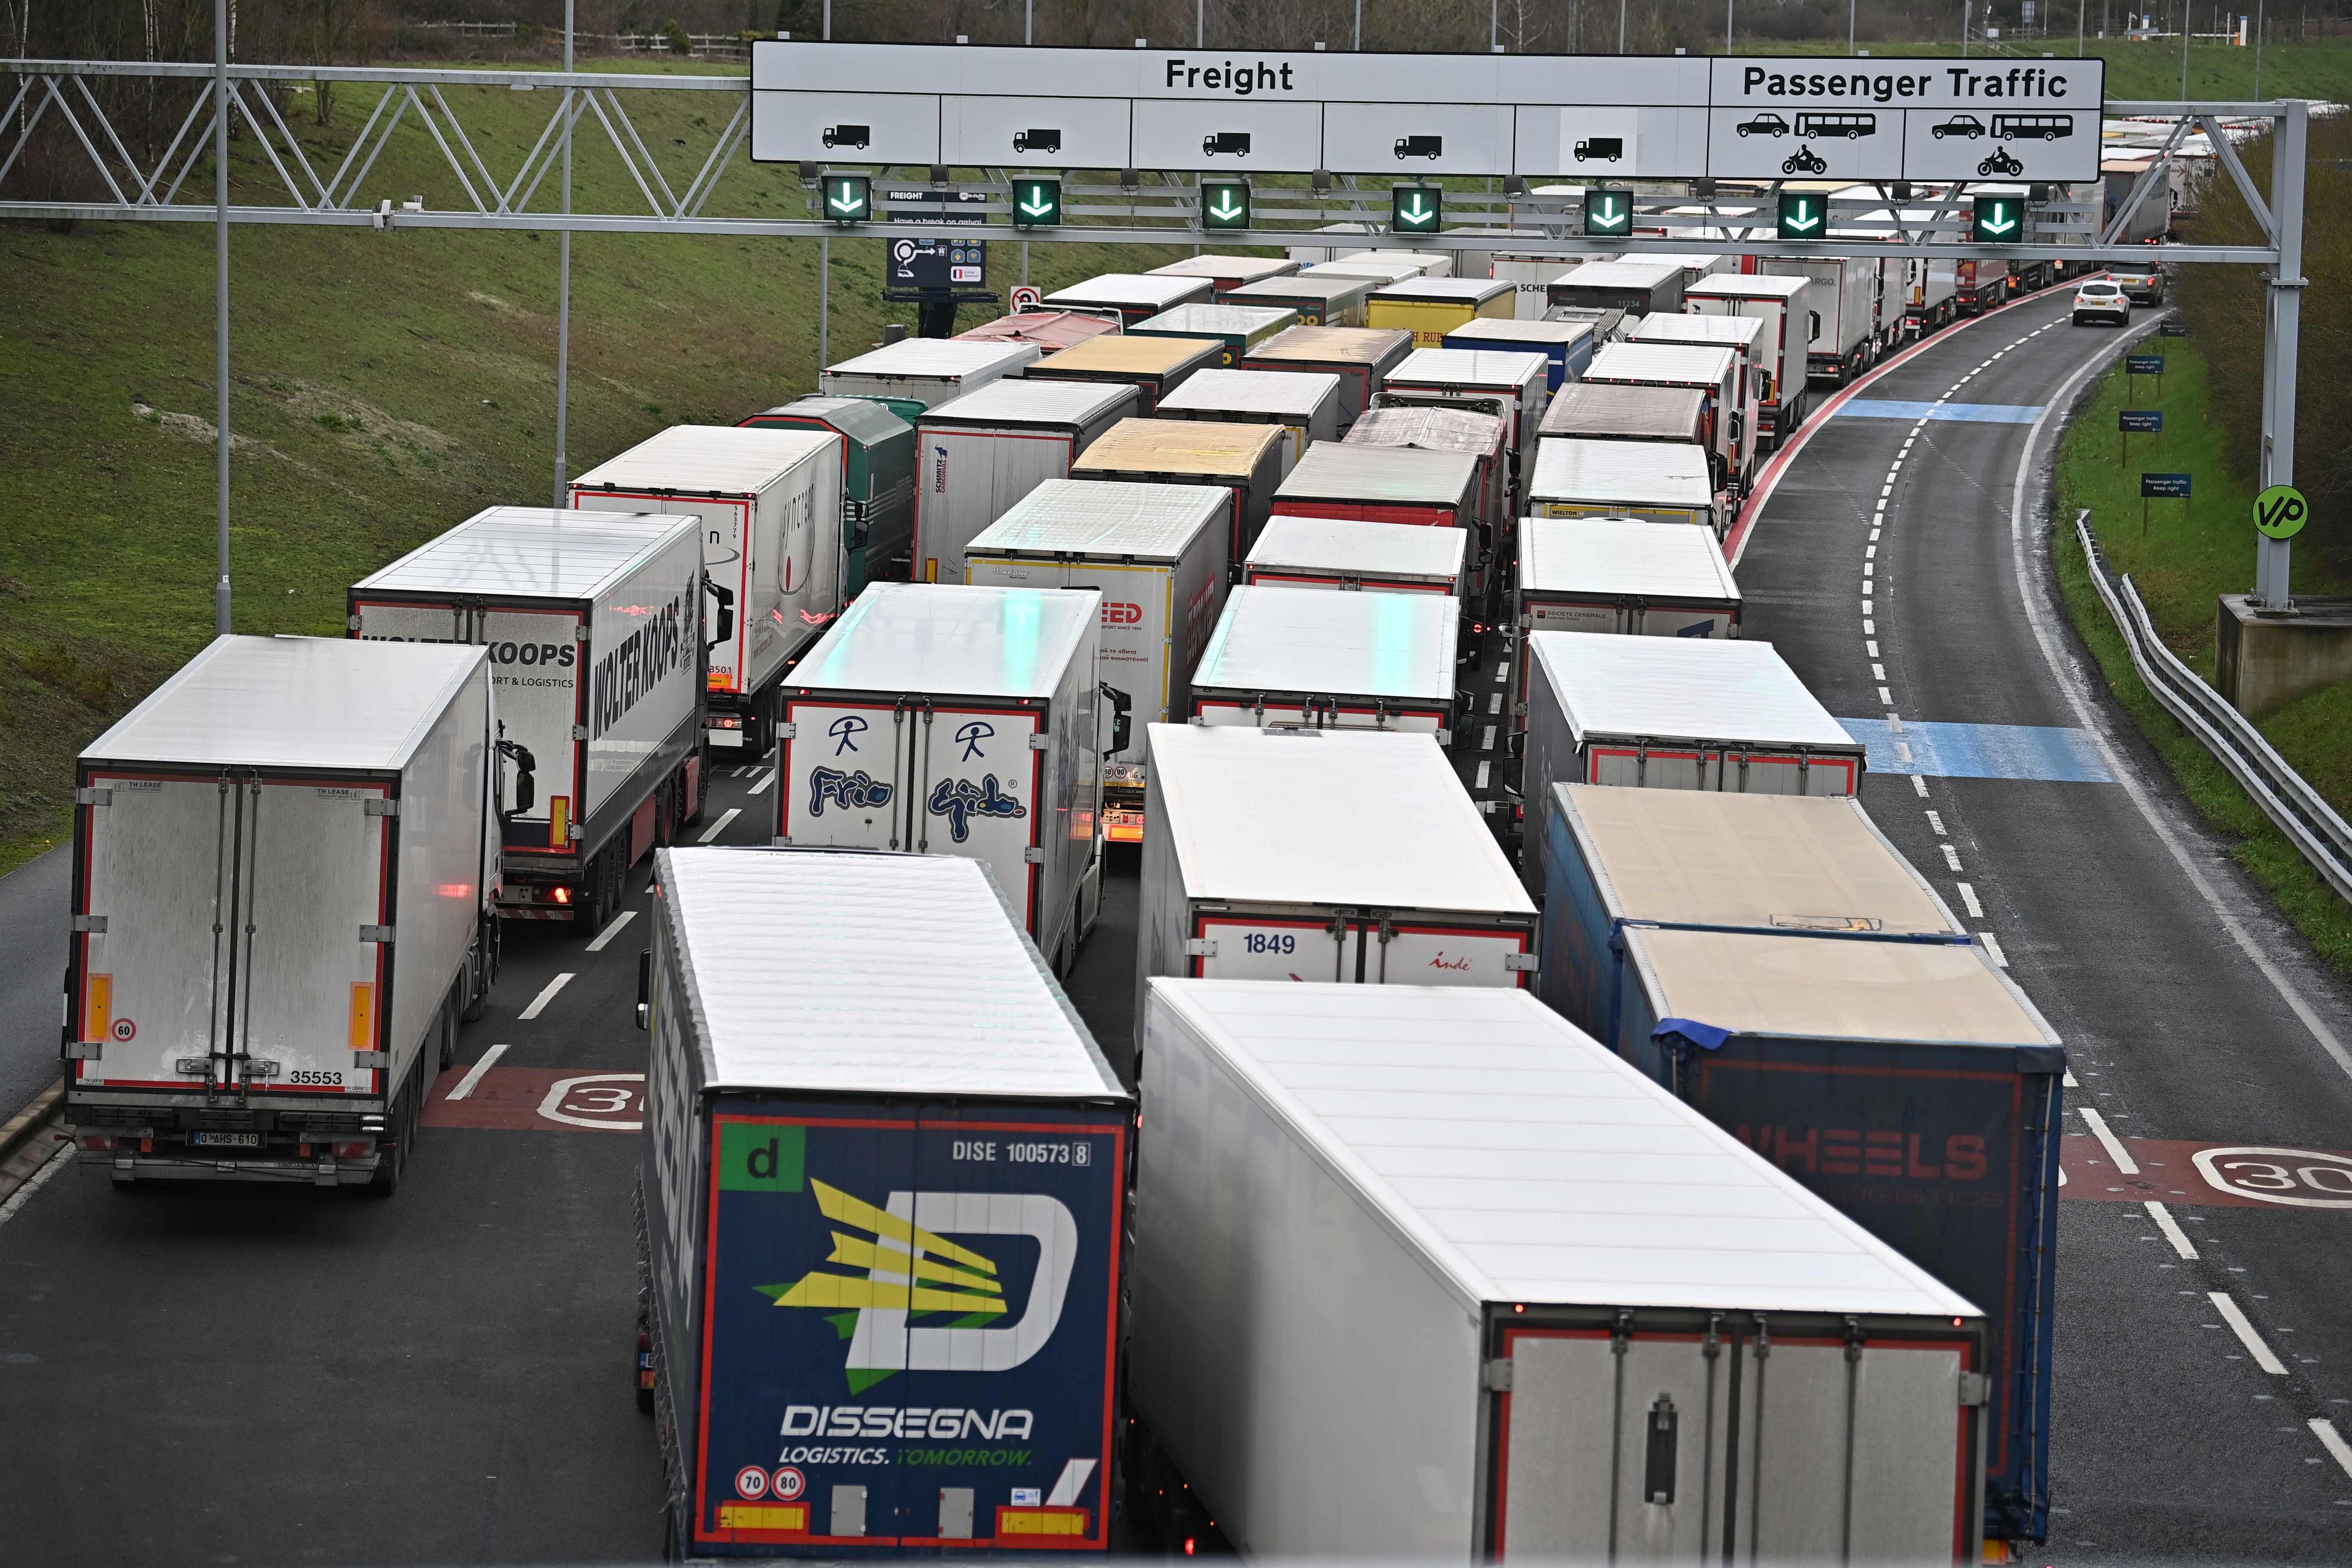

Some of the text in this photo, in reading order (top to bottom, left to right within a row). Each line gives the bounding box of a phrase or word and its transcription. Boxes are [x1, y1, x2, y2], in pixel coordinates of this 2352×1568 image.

[1167, 59, 1293, 95] Freight
[1743, 66, 2067, 102] Passenger Traffic
[481, 641, 576, 667] KOOPS
[594, 595, 679, 741] WOLTER KOOPS
[512, 677, 519, 686] &
[522, 678, 573, 688] LOGISTICS
[1244, 934, 1295, 955] 1849
[118, 1025, 130, 1035] 60
[290, 1070, 343, 1085] 35553
[565, 1088, 644, 1112] 3
[746, 1138, 778, 1179] d
[952, 1142, 997, 1161] DISE
[1006, 1144, 1070, 1164] 100573
[2224, 1162, 2352, 1193] 30
[780, 1405, 1034, 1440] DISSEGNA
[779, 1446, 1033, 1466] LOGISTICS. TOMORROW.
[745, 1476, 761, 1489] 70
[780, 1477, 797, 1490] 80
